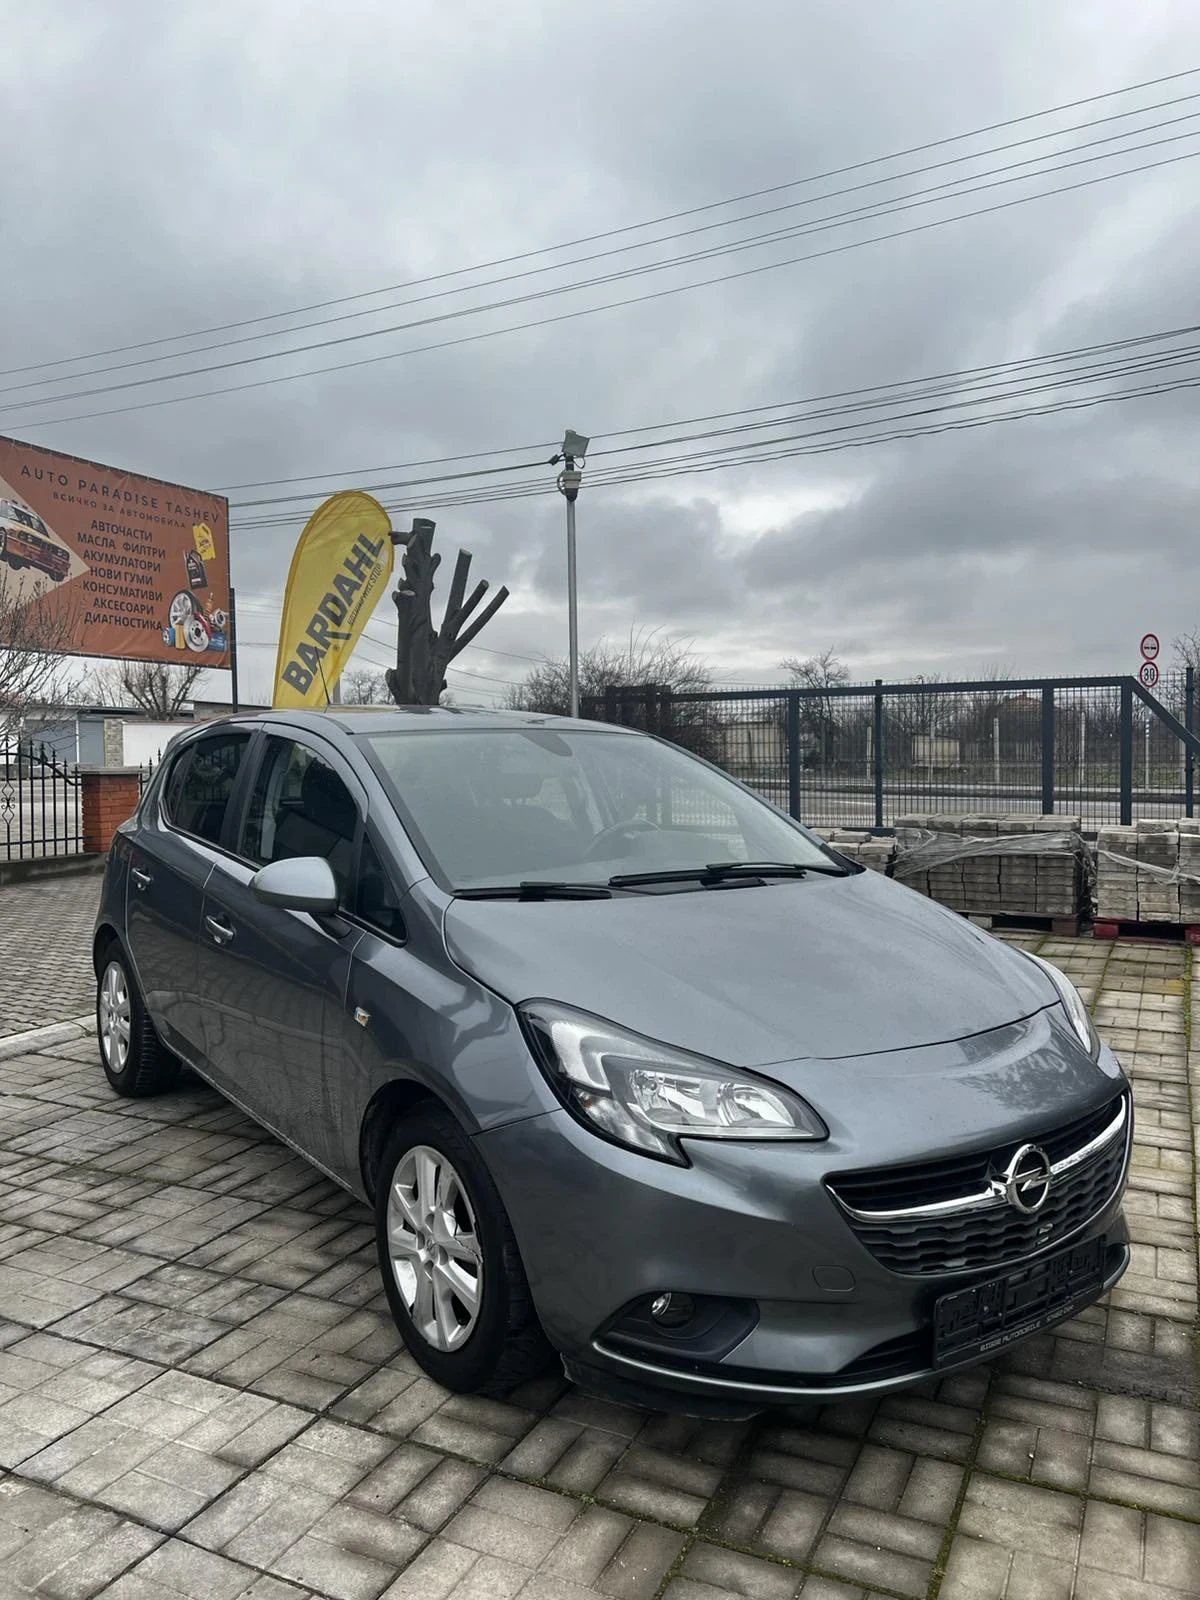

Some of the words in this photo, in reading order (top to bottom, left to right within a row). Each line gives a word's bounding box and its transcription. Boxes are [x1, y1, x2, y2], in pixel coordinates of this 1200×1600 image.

[21, 464, 68, 487] AUTO
[78, 479, 158, 509] PARADISE
[166, 501, 219, 523] TASHEV
[53, 491, 97, 508] ВСИЧКО
[103, 503, 114, 513] ЗА
[120, 507, 186, 529] АВТОМОБИЛА
[91, 519, 153, 543] АВТОЧАСТИ
[77, 532, 116, 549] МАСЛА
[122, 541, 166, 559] ФИЛТРИ
[83, 549, 161, 573] АКУМУЛАТОРИ
[90, 565, 122, 581] НОВИ
[124, 571, 153, 586] ГУМИ
[369, 562, 383, 585] STOP
[82, 580, 163, 602] КОНСУМАТИВИ
[92, 597, 155, 615] АКСЕСОАРИ
[281, 533, 385, 696] BARDAHL
[83, 611, 163, 631] ДИАГНОСТИКА
[1143, 667, 1155, 682] 30
